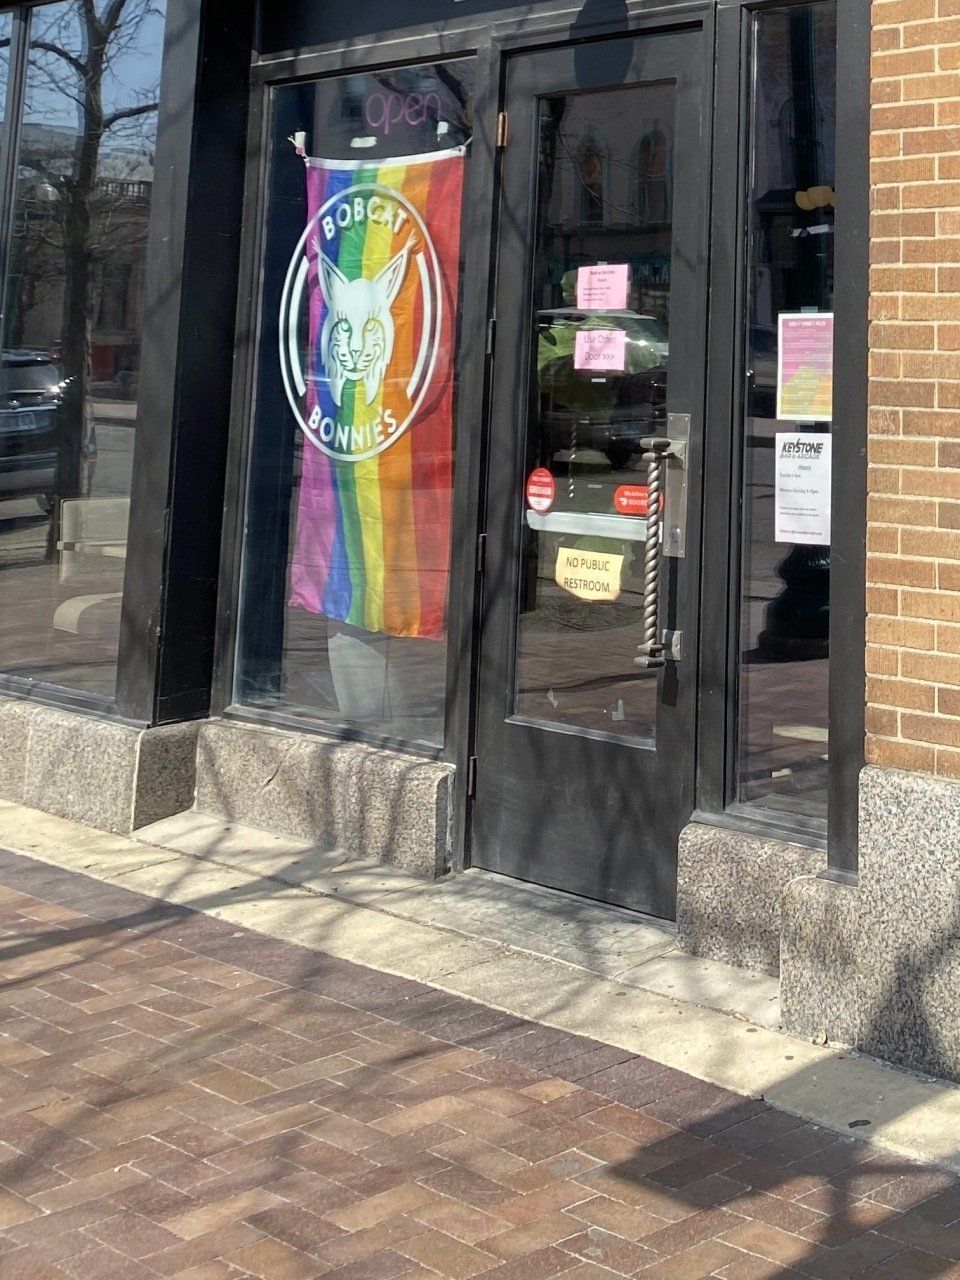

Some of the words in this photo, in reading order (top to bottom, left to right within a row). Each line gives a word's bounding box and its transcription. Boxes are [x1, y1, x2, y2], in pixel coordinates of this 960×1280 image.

[365, 92, 443, 135] open
[322, 196, 408, 241] BOBCAT
[308, 404, 397, 452] BONNIE'S
[782, 438, 824, 454] KEYSTONE
[566, 557, 578, 568] NO
[581, 559, 610, 571] PUBLIC
[564, 578, 611, 593] RESTROOM
